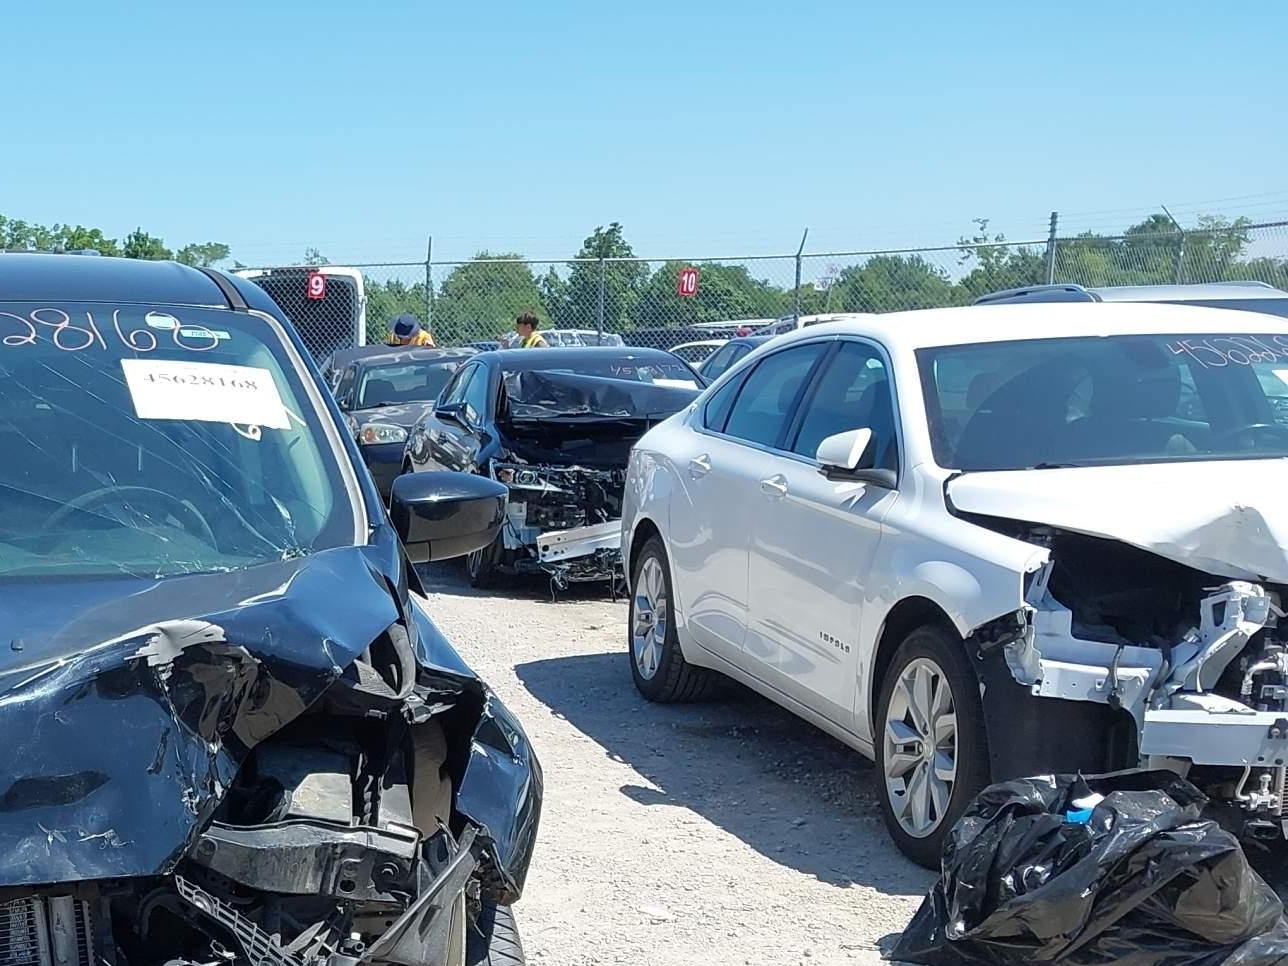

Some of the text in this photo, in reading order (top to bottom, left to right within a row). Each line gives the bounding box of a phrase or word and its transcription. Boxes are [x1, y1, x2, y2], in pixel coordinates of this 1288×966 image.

[311, 275, 323, 296] 9
[682, 272, 696, 292] 10
[143, 373, 258, 391] 45628168
